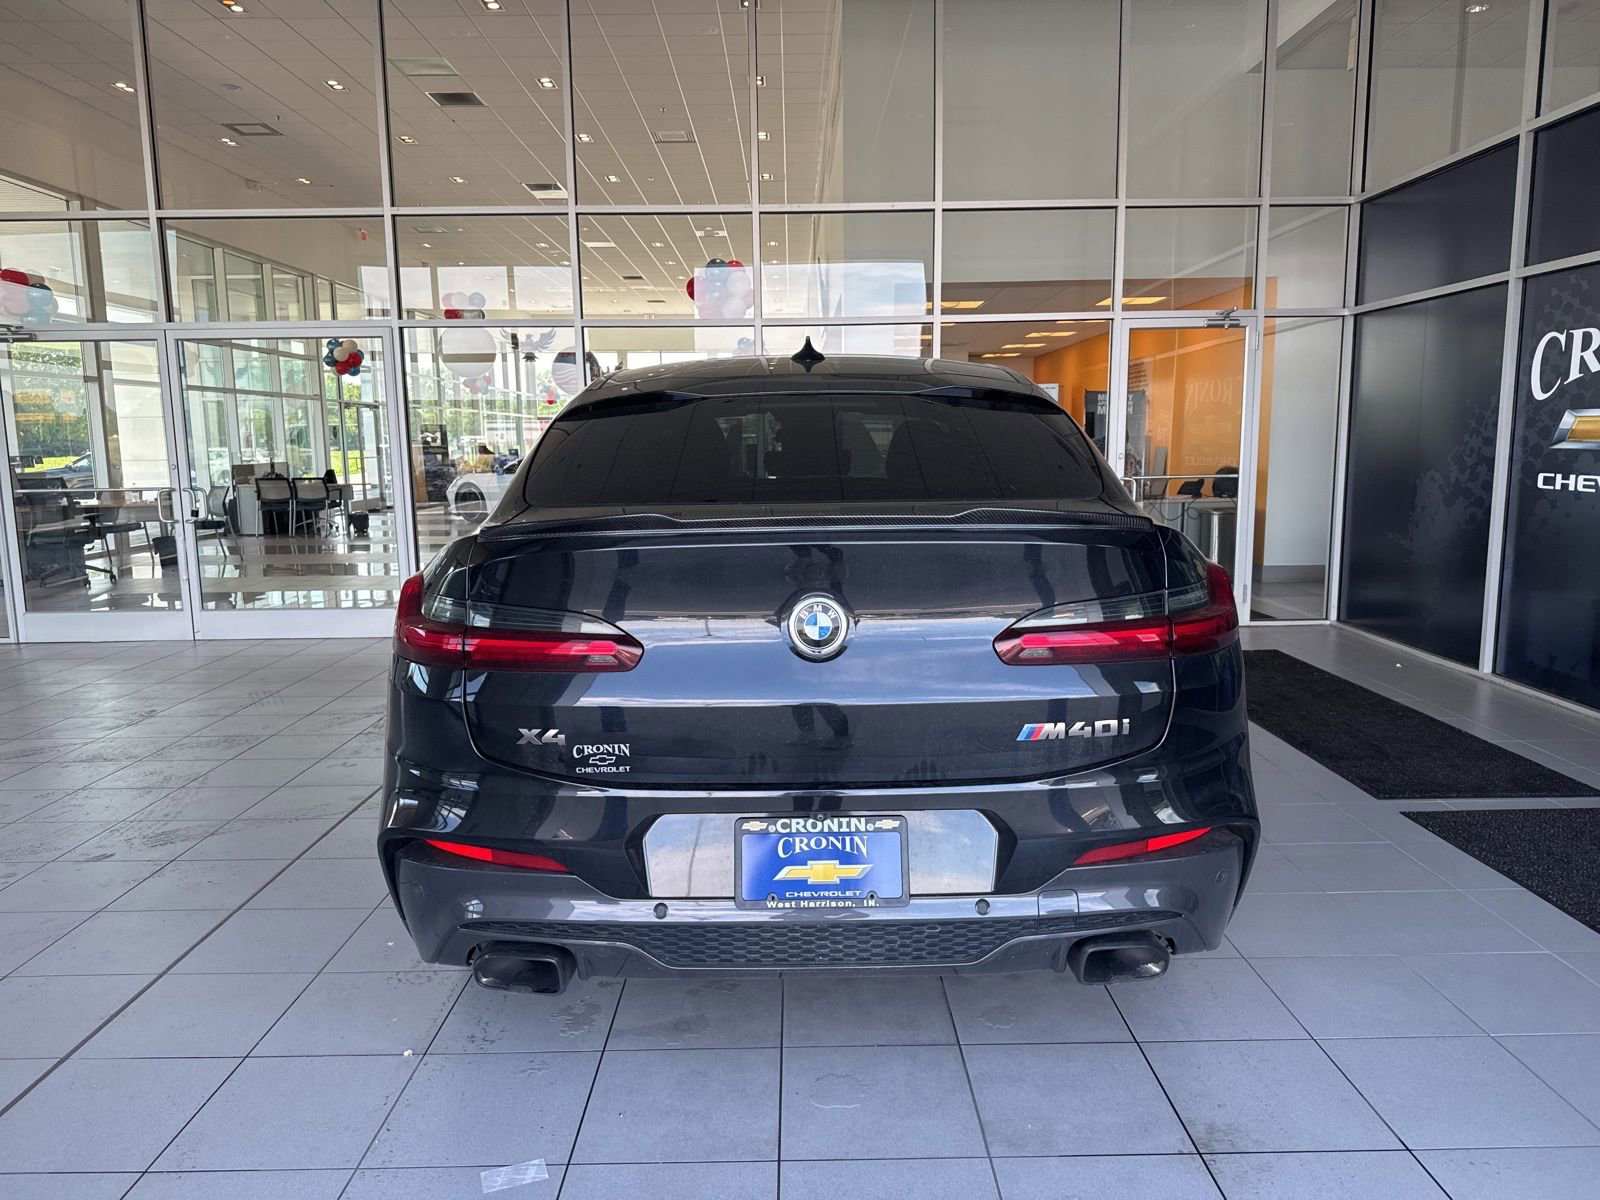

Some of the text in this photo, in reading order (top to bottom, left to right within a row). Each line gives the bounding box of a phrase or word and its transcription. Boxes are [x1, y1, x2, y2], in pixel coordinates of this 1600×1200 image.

[1537, 472, 1600, 492] CHE
[799, 604, 837, 620] BMW
[516, 728, 566, 745] X4
[1037, 718, 1130, 740] M40i
[572, 743, 630, 758] CRONIN
[576, 765, 631, 773] CHEVROLET
[775, 817, 867, 832] CRONIN
[777, 836, 868, 858] CRONIN
[786, 890, 862, 898] CHEVROLET
